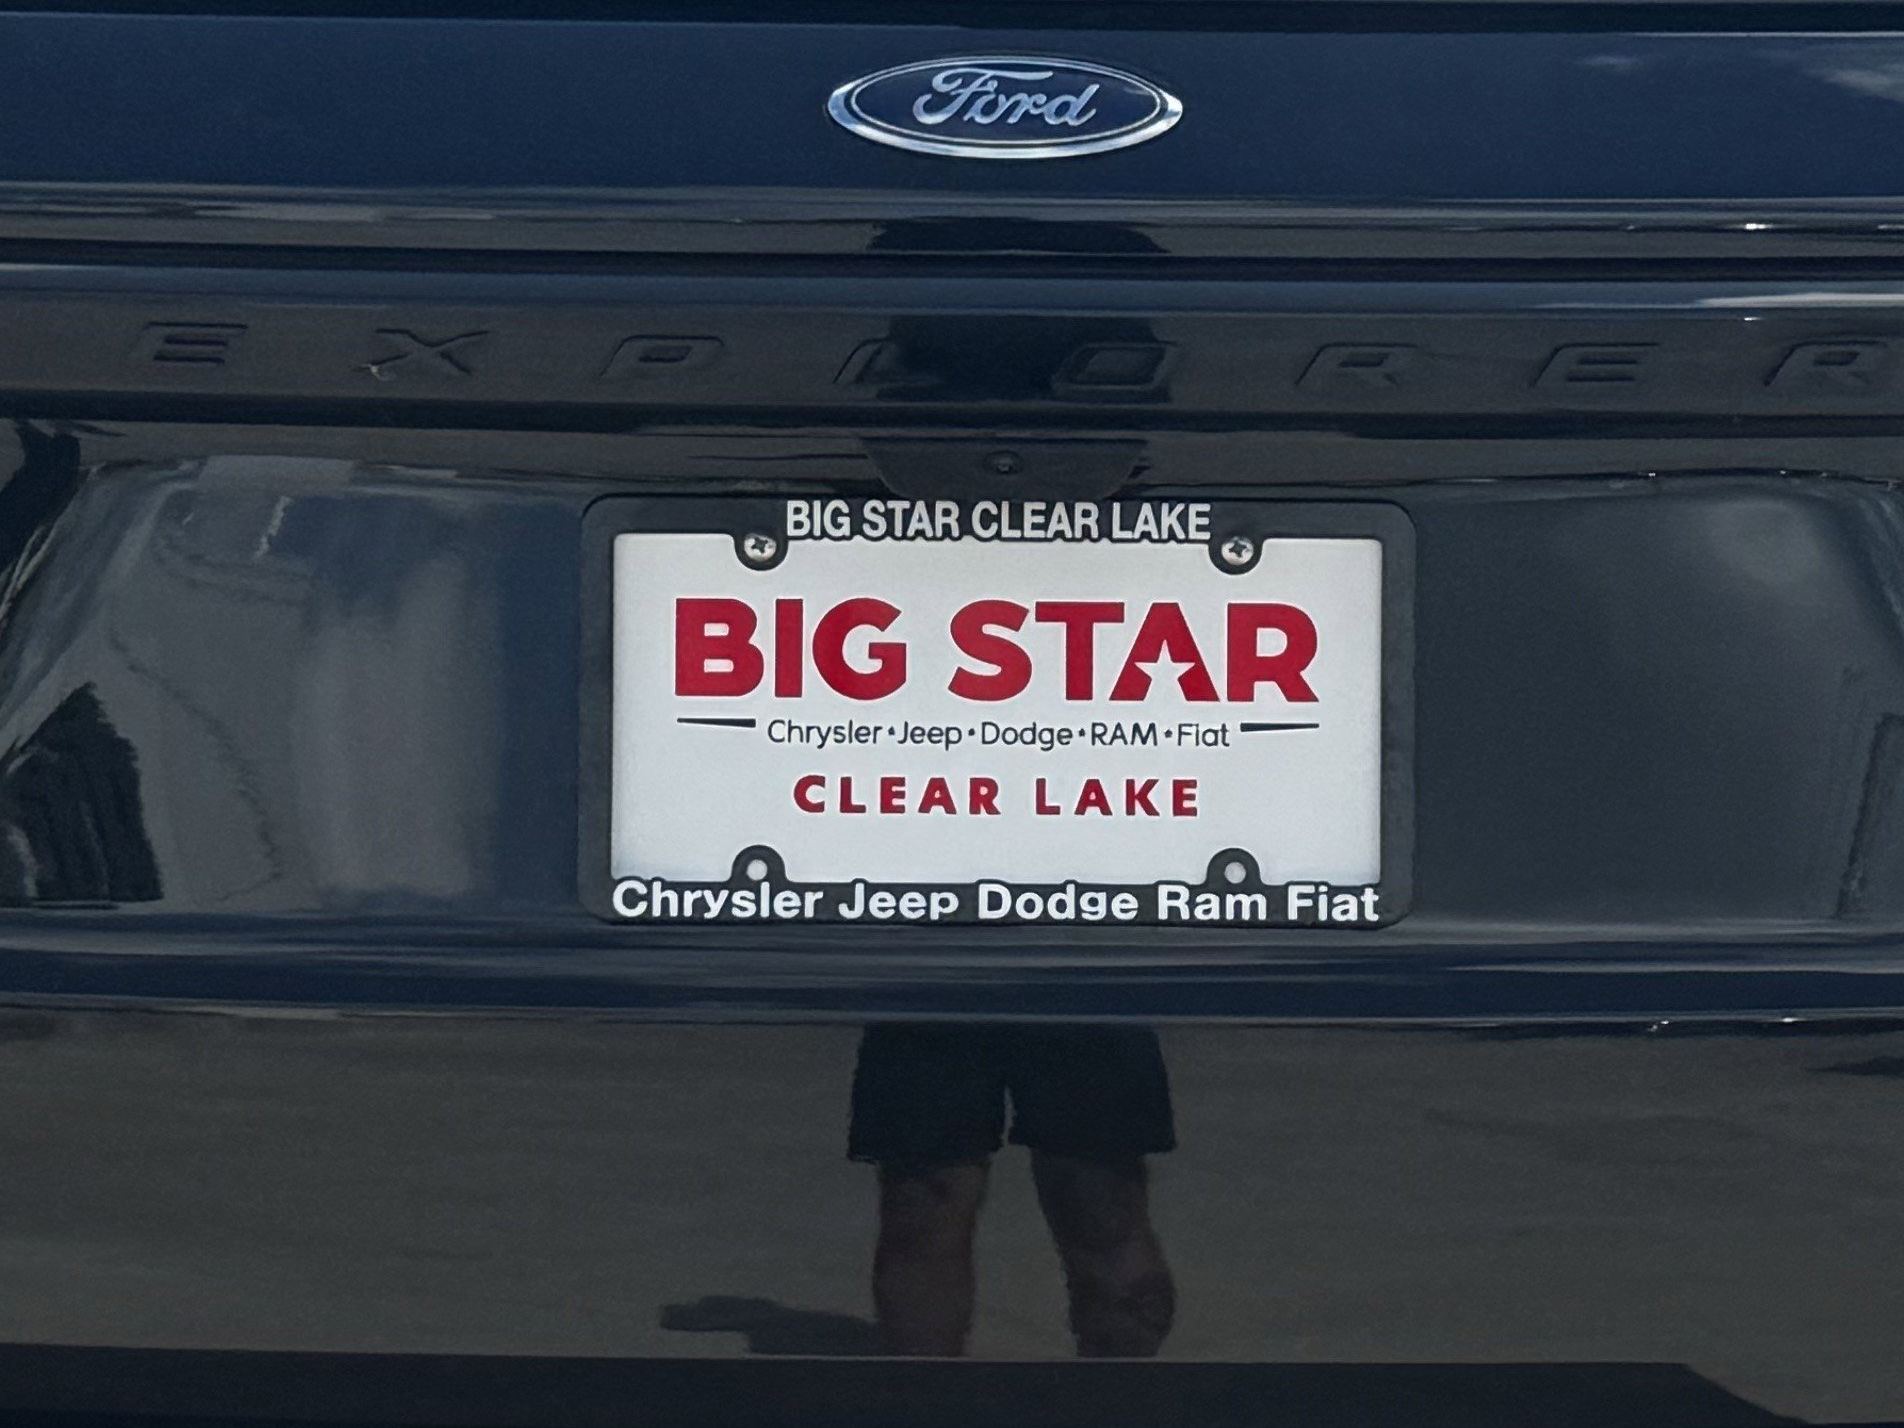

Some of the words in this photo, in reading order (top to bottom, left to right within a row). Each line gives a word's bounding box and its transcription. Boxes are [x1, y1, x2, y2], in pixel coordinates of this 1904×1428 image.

[912, 67, 1100, 127] Ford
[126, 320, 1889, 390] EXPLORER
[786, 499, 851, 538] BIG
[862, 500, 960, 539] STAR
[971, 501, 1100, 540] CLEAR
[1111, 502, 1212, 540] LAKE
[674, 598, 907, 701] BIG
[949, 600, 1319, 702] STAR
[767, 719, 881, 750] Chrysler
[897, 721, 964, 751] Jeep
[981, 721, 1073, 752] Dodge
[1091, 722, 1158, 747] RAM
[1177, 722, 1230, 748] Fiat
[793, 775, 999, 816] CLEAR
[1035, 779, 1199, 817] LAKE
[612, 880, 824, 920] Chrysler
[838, 882, 960, 921] Jeep
[978, 883, 1139, 920] Dodge
[1157, 884, 1267, 921] Ram
[1287, 884, 1380, 922] Fiat
